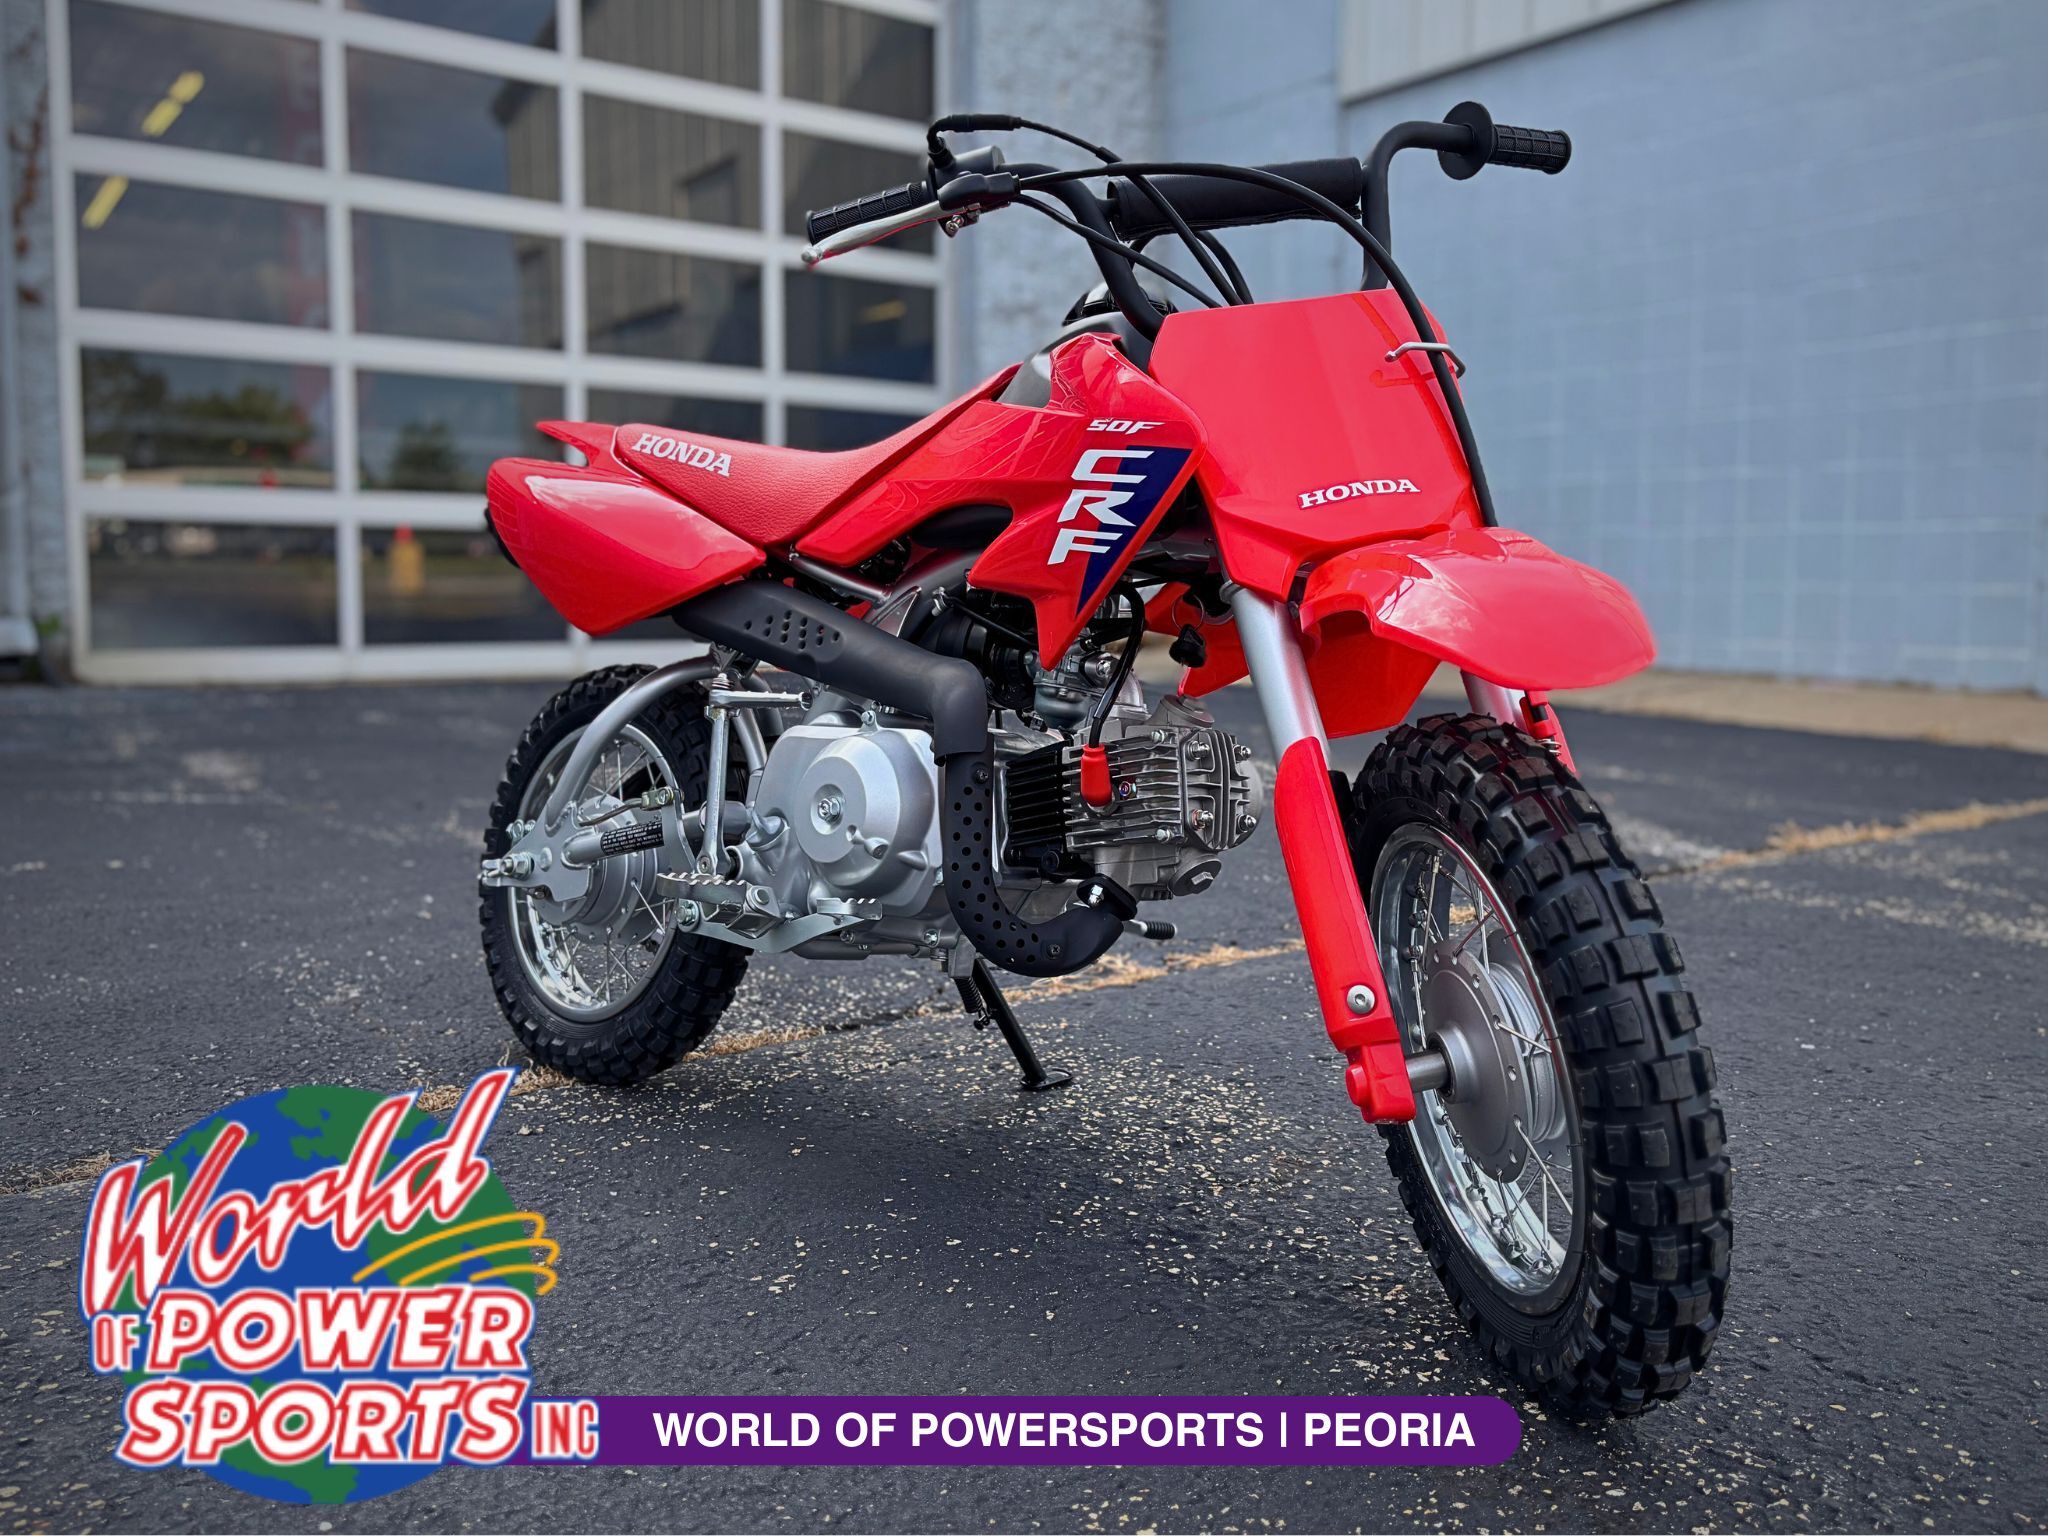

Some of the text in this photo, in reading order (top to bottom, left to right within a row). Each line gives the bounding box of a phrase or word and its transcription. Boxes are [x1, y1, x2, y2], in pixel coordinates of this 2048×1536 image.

[1086, 417, 1165, 435] 50F
[632, 432, 732, 477] HONDA
[1047, 449, 1155, 565] CRF
[1299, 479, 1421, 508] HONDA
